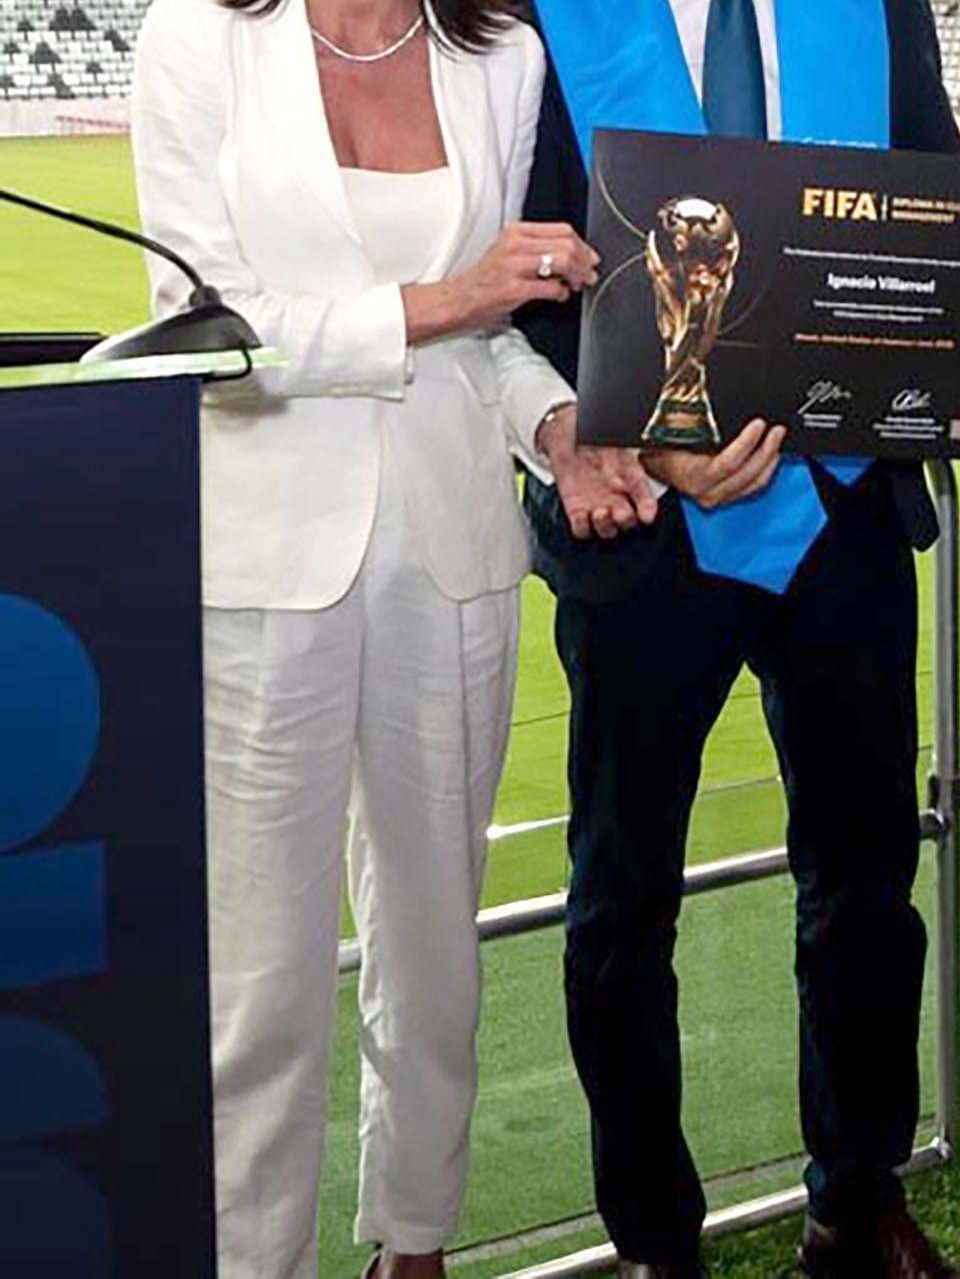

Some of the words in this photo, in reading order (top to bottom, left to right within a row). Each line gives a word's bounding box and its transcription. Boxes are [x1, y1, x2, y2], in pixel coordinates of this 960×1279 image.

[802, 187, 878, 221] FIFA
[827, 272, 877, 290] Ignacio
[878, 275, 936, 294] Villarroel
